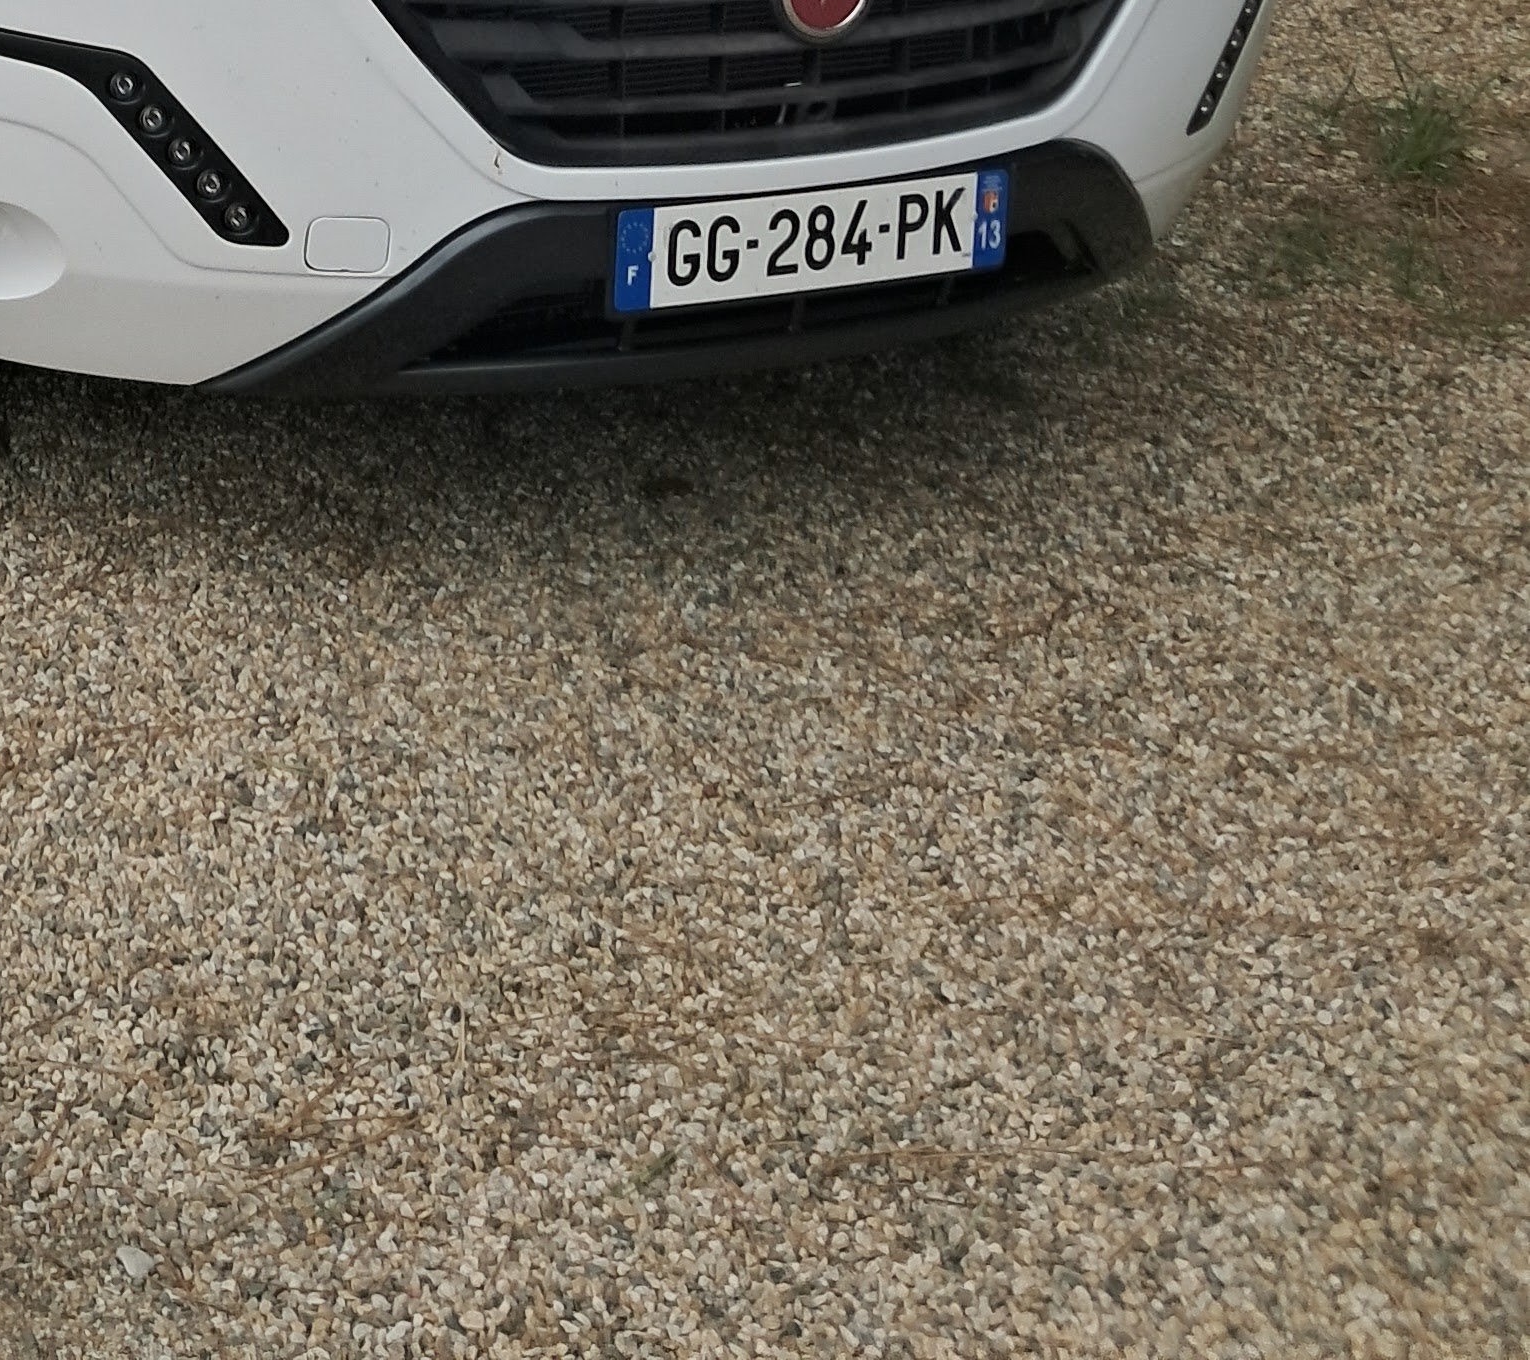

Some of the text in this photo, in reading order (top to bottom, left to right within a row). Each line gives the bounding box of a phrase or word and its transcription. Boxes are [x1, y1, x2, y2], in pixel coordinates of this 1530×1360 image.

[627, 186, 1001, 287] F GG-284-PK 13
